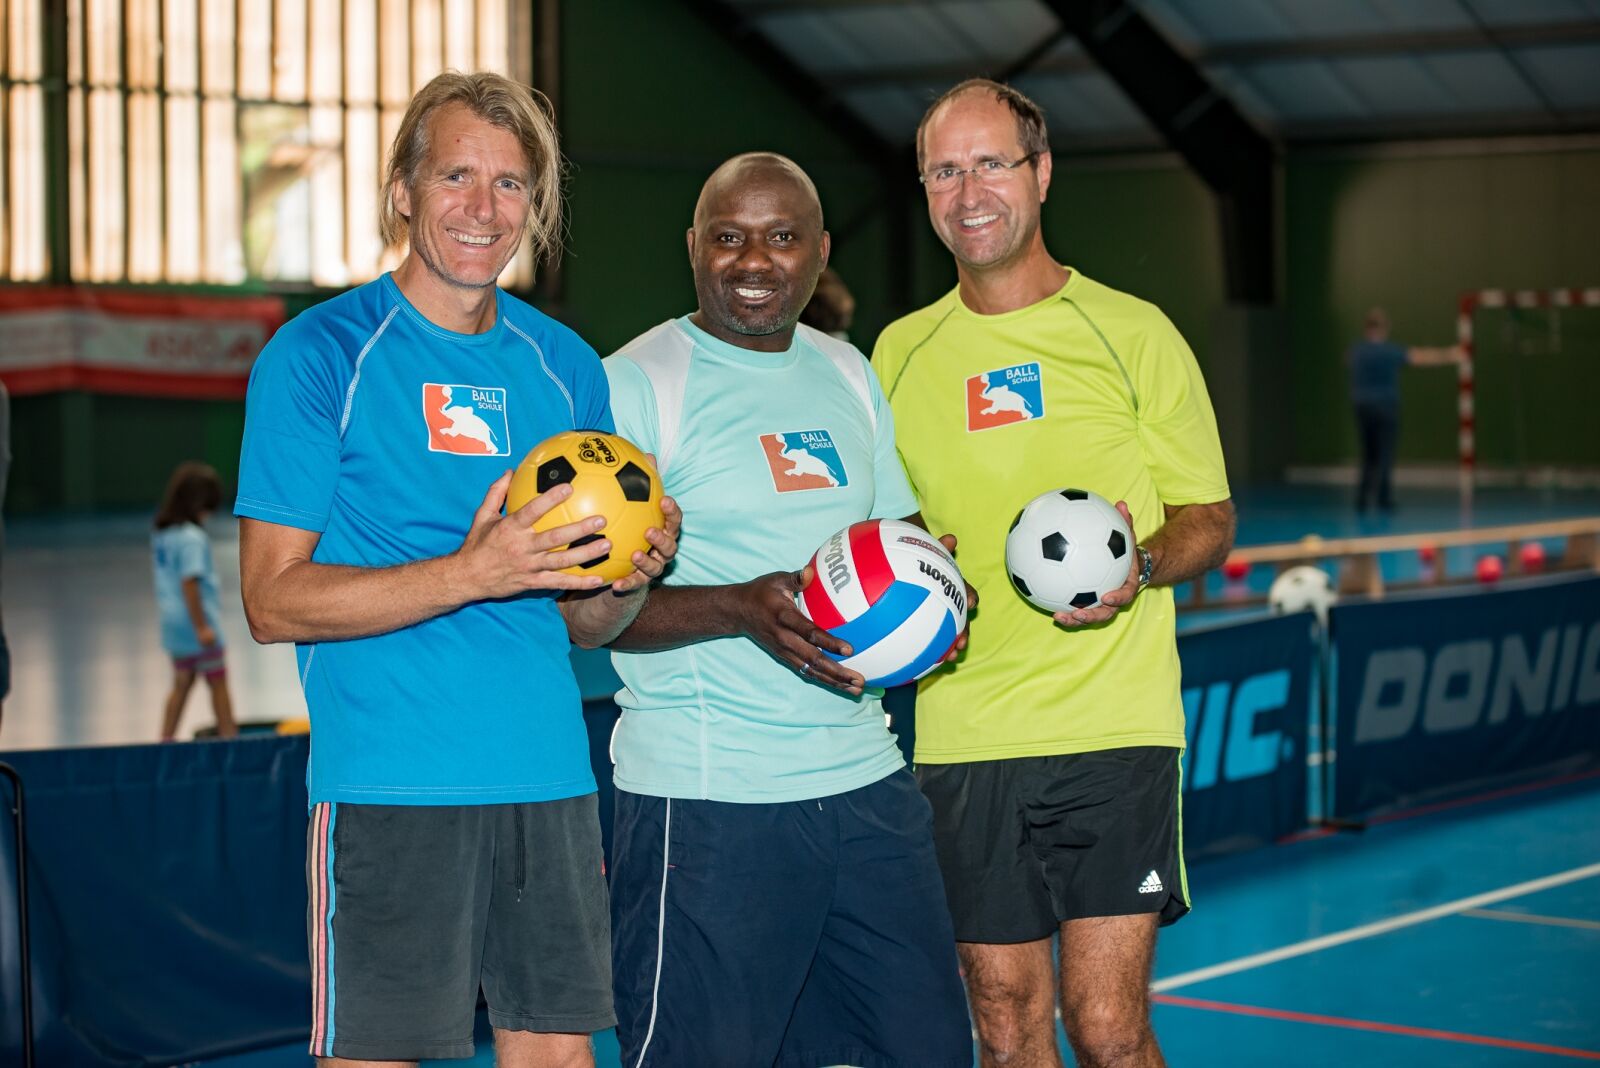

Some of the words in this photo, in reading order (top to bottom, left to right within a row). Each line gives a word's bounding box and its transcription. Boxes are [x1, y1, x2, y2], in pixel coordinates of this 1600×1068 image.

[1005, 366, 1035, 380] BALL
[1011, 375, 1038, 385] SCHULE
[472, 389, 499, 404] BALL
[478, 402, 502, 412] SCHULE
[800, 431, 828, 444] BALL
[809, 441, 834, 450] SCHULE
[918, 560, 965, 616] Wilson
